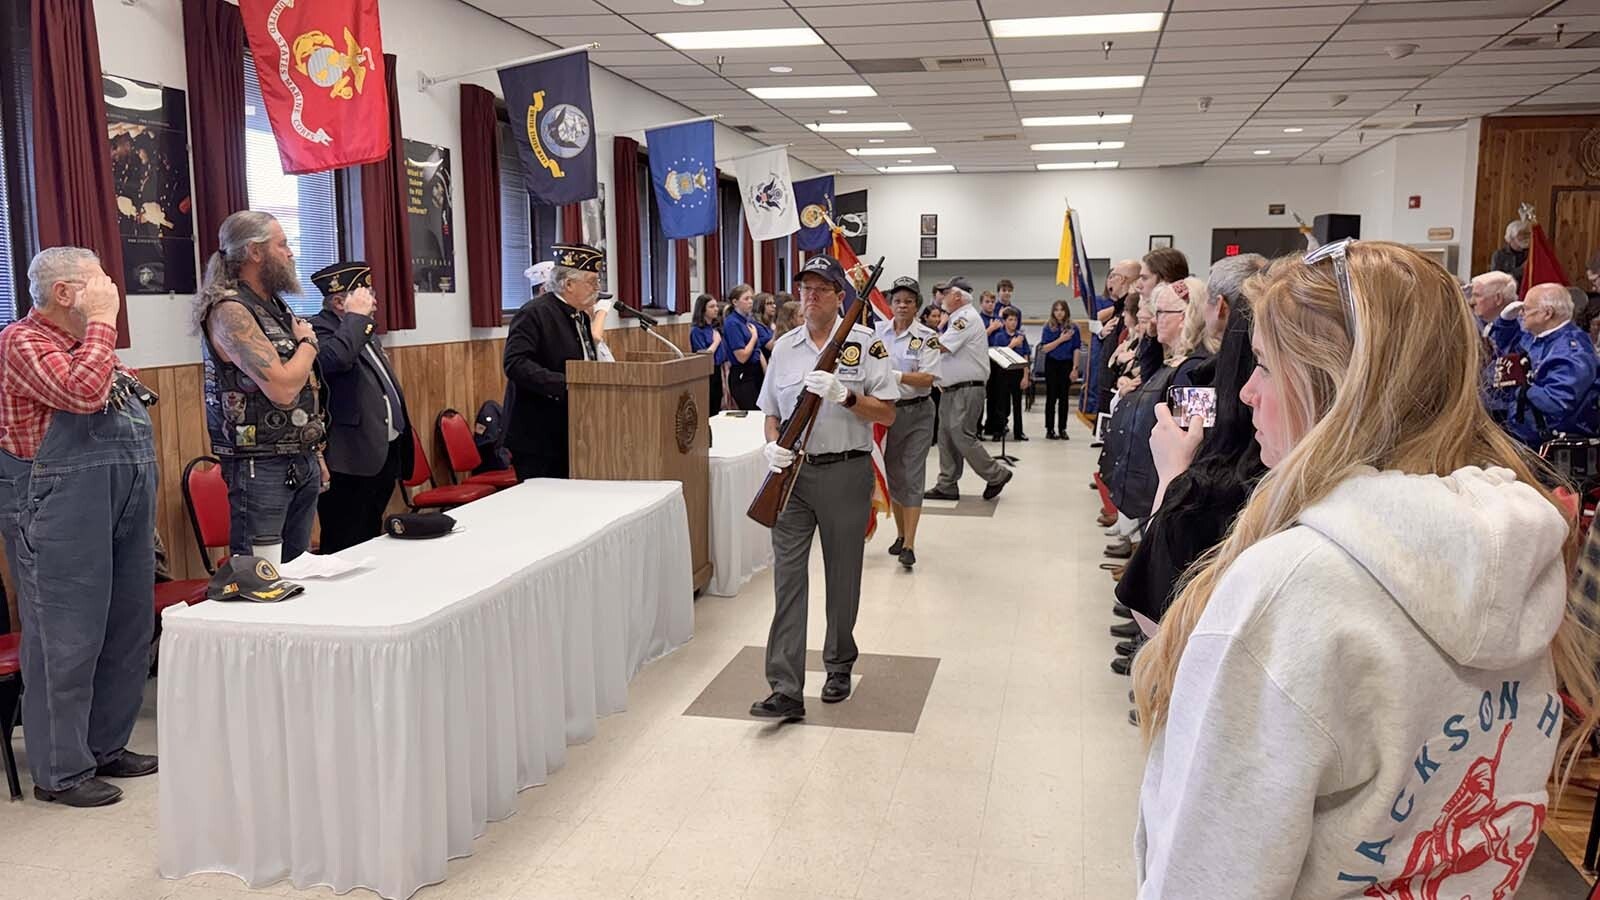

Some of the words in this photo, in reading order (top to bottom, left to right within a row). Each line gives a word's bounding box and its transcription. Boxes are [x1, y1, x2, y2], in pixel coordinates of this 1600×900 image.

[269, 1, 285, 34] UNITED
[278, 37, 289, 75] STATES
[284, 78, 302, 113] MARINE
[293, 119, 315, 140] CORPS
[538, 150, 548, 164] NAVY
